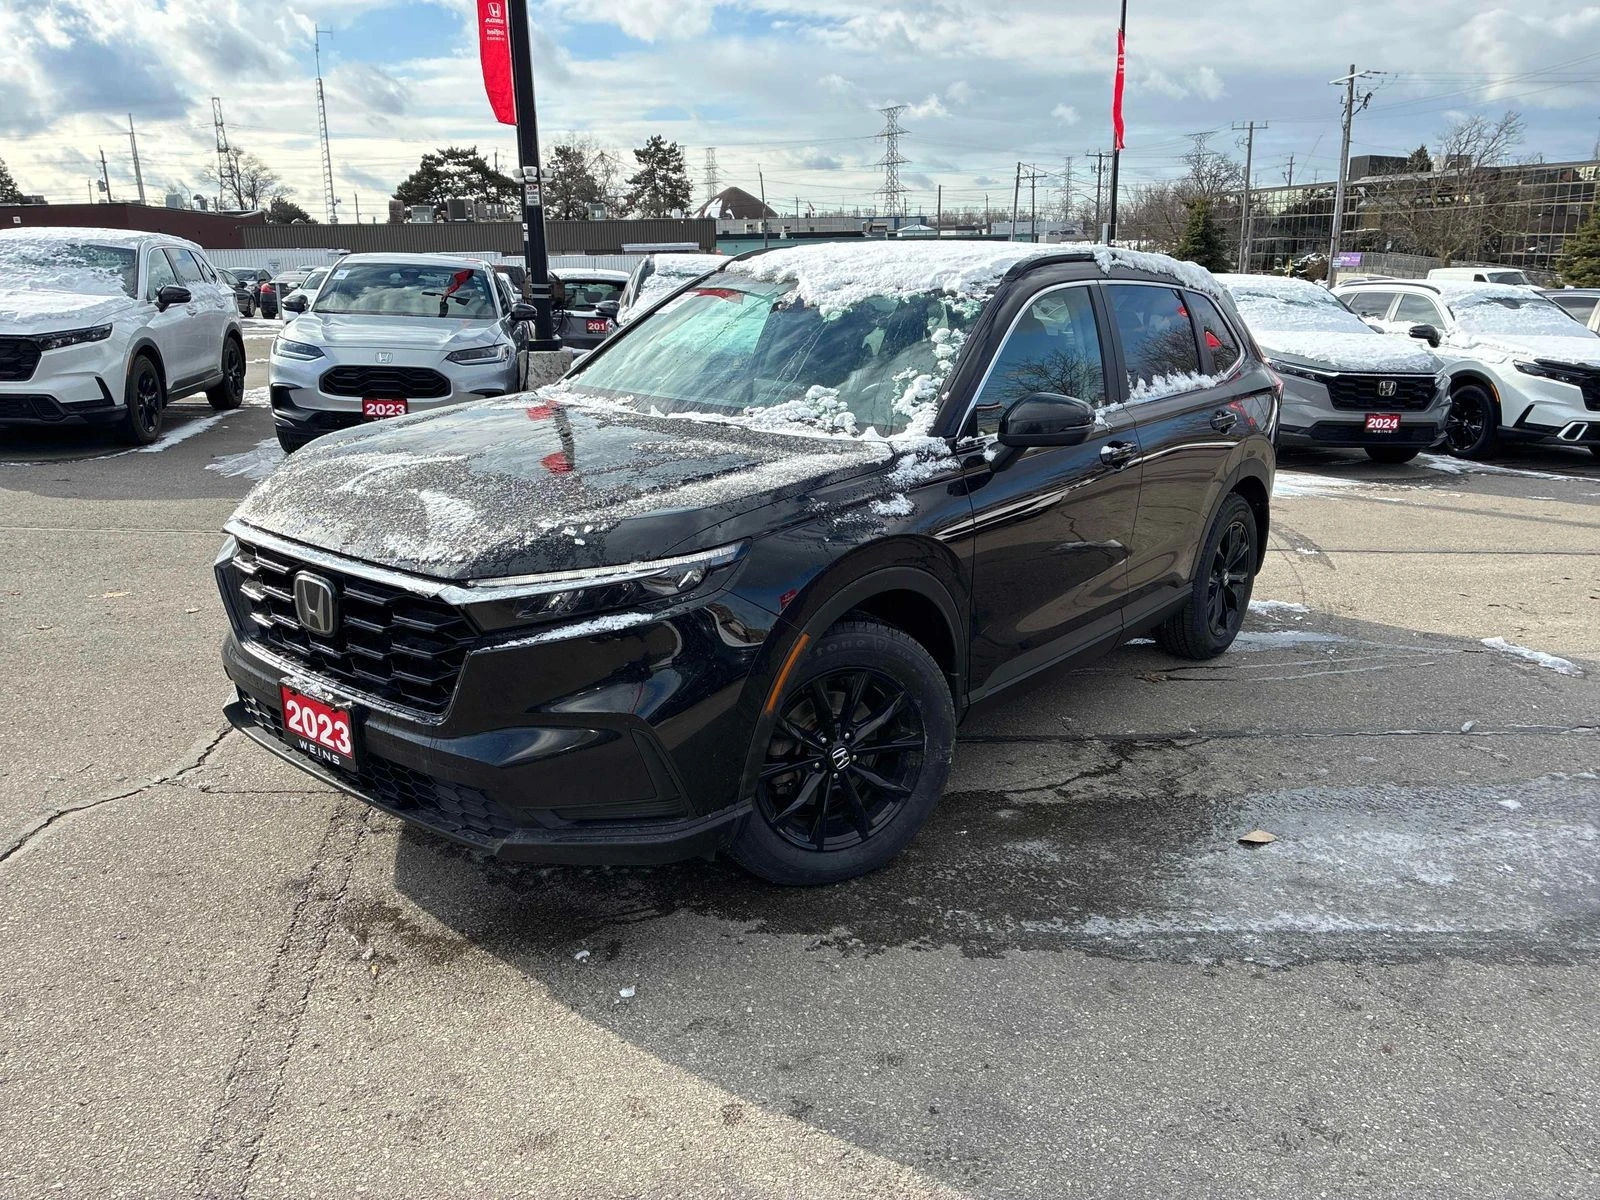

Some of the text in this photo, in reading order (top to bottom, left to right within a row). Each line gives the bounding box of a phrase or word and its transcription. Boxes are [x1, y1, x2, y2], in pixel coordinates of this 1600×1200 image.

[588, 322, 606, 330] 201
[366, 403, 406, 416] 2023
[1367, 418, 1398, 429] 2024
[286, 700, 352, 754] 2023
[299, 739, 340, 765] WEINS
